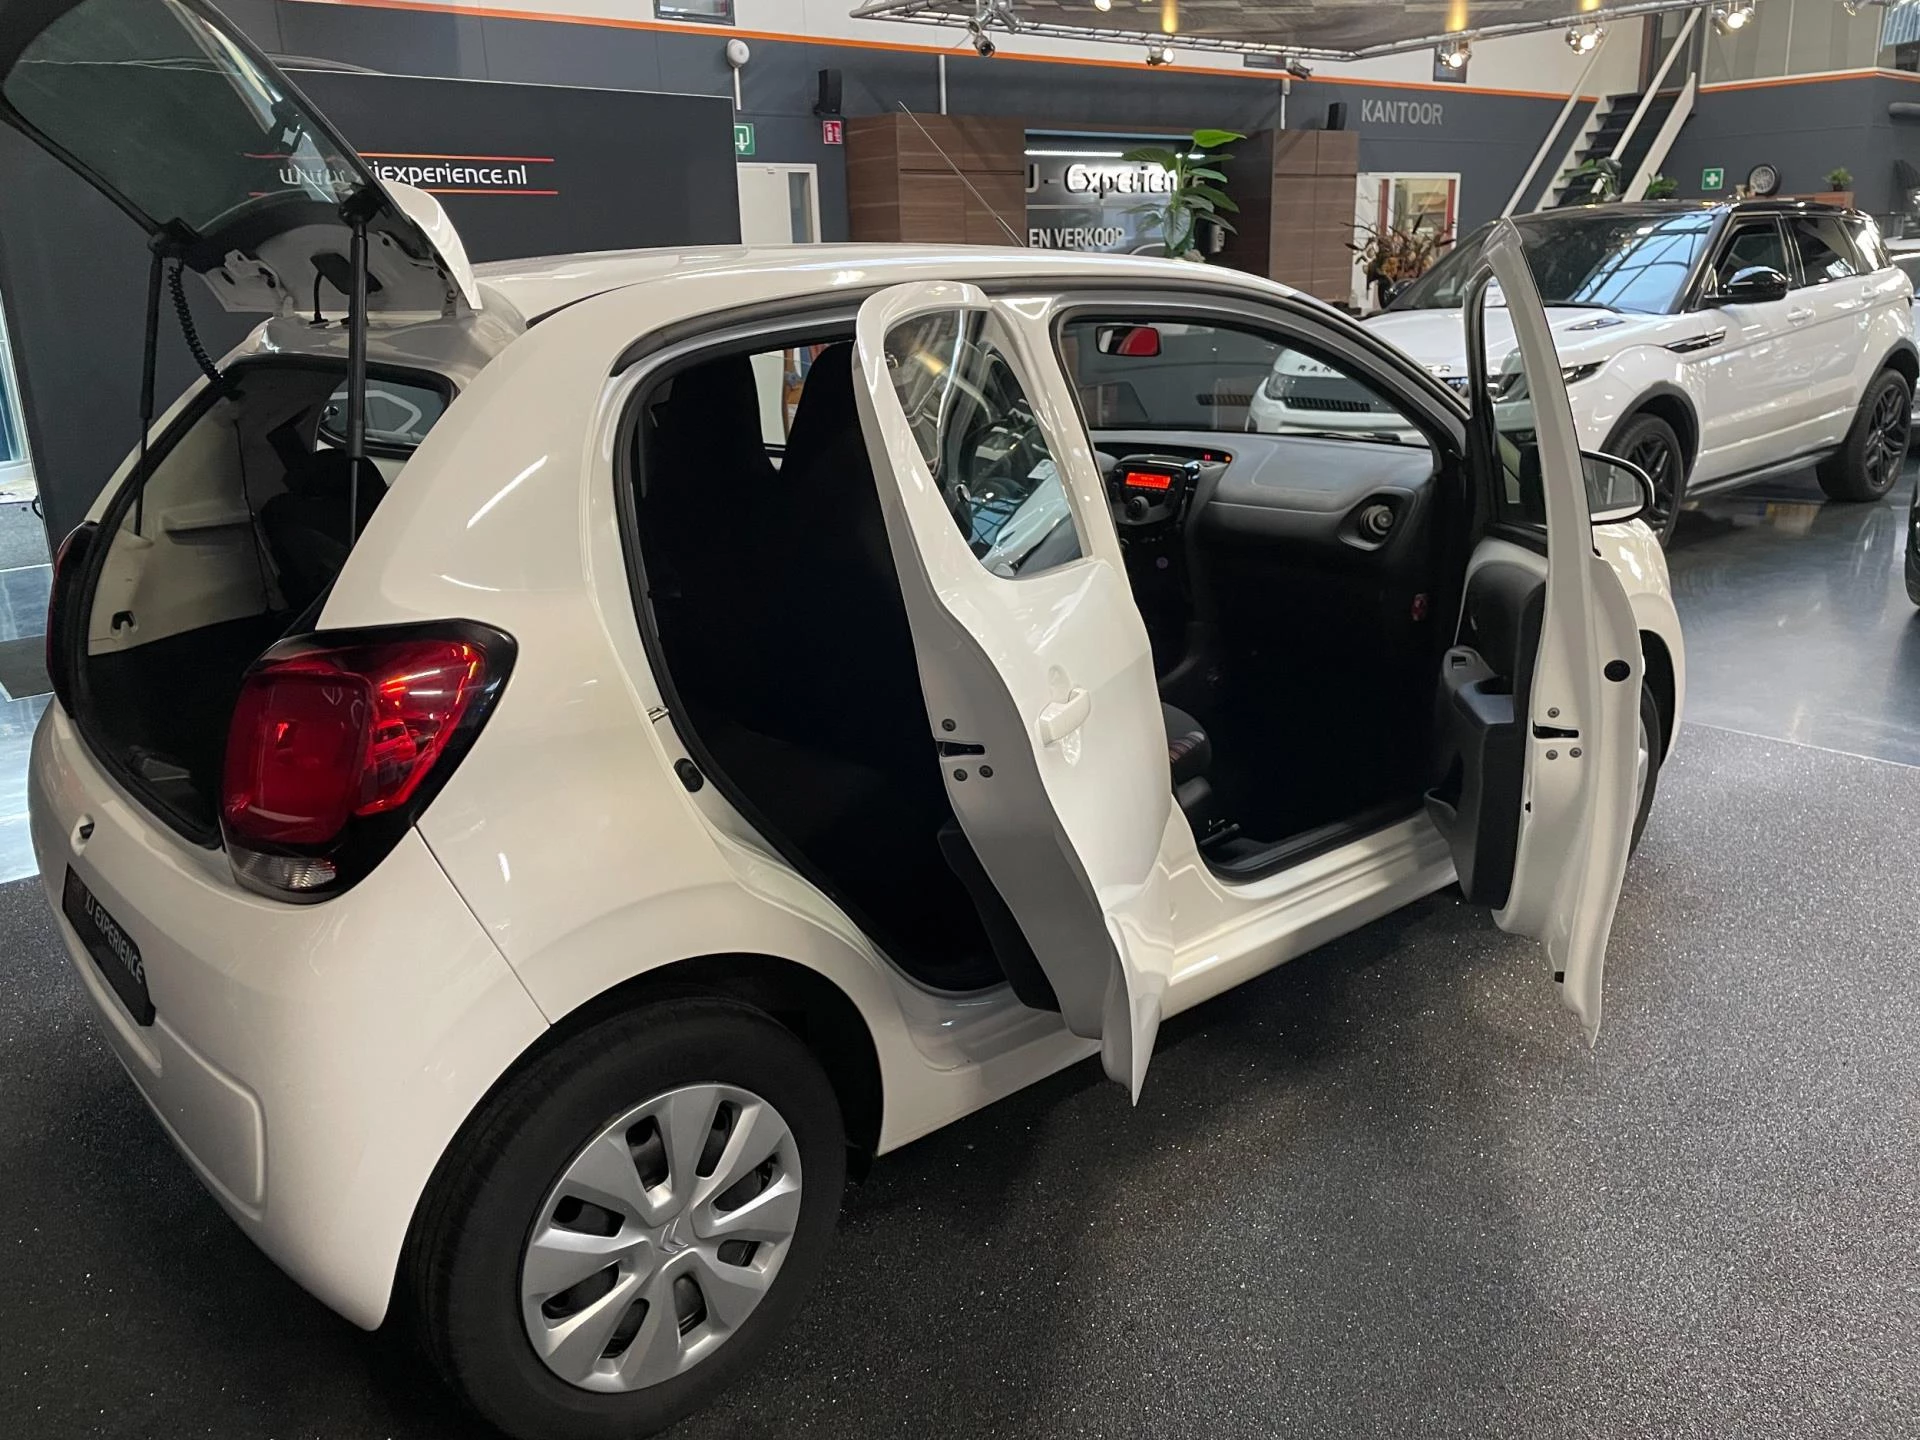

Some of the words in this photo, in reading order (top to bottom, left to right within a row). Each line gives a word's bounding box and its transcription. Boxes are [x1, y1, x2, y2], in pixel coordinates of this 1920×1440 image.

[1361, 99, 1443, 125] KANTOOR
[1028, 228, 1051, 248] EN
[1055, 227, 1125, 248] VERKOOP
[1297, 364, 1333, 374] RAN
[95, 905, 143, 984] EXPERIENCE
